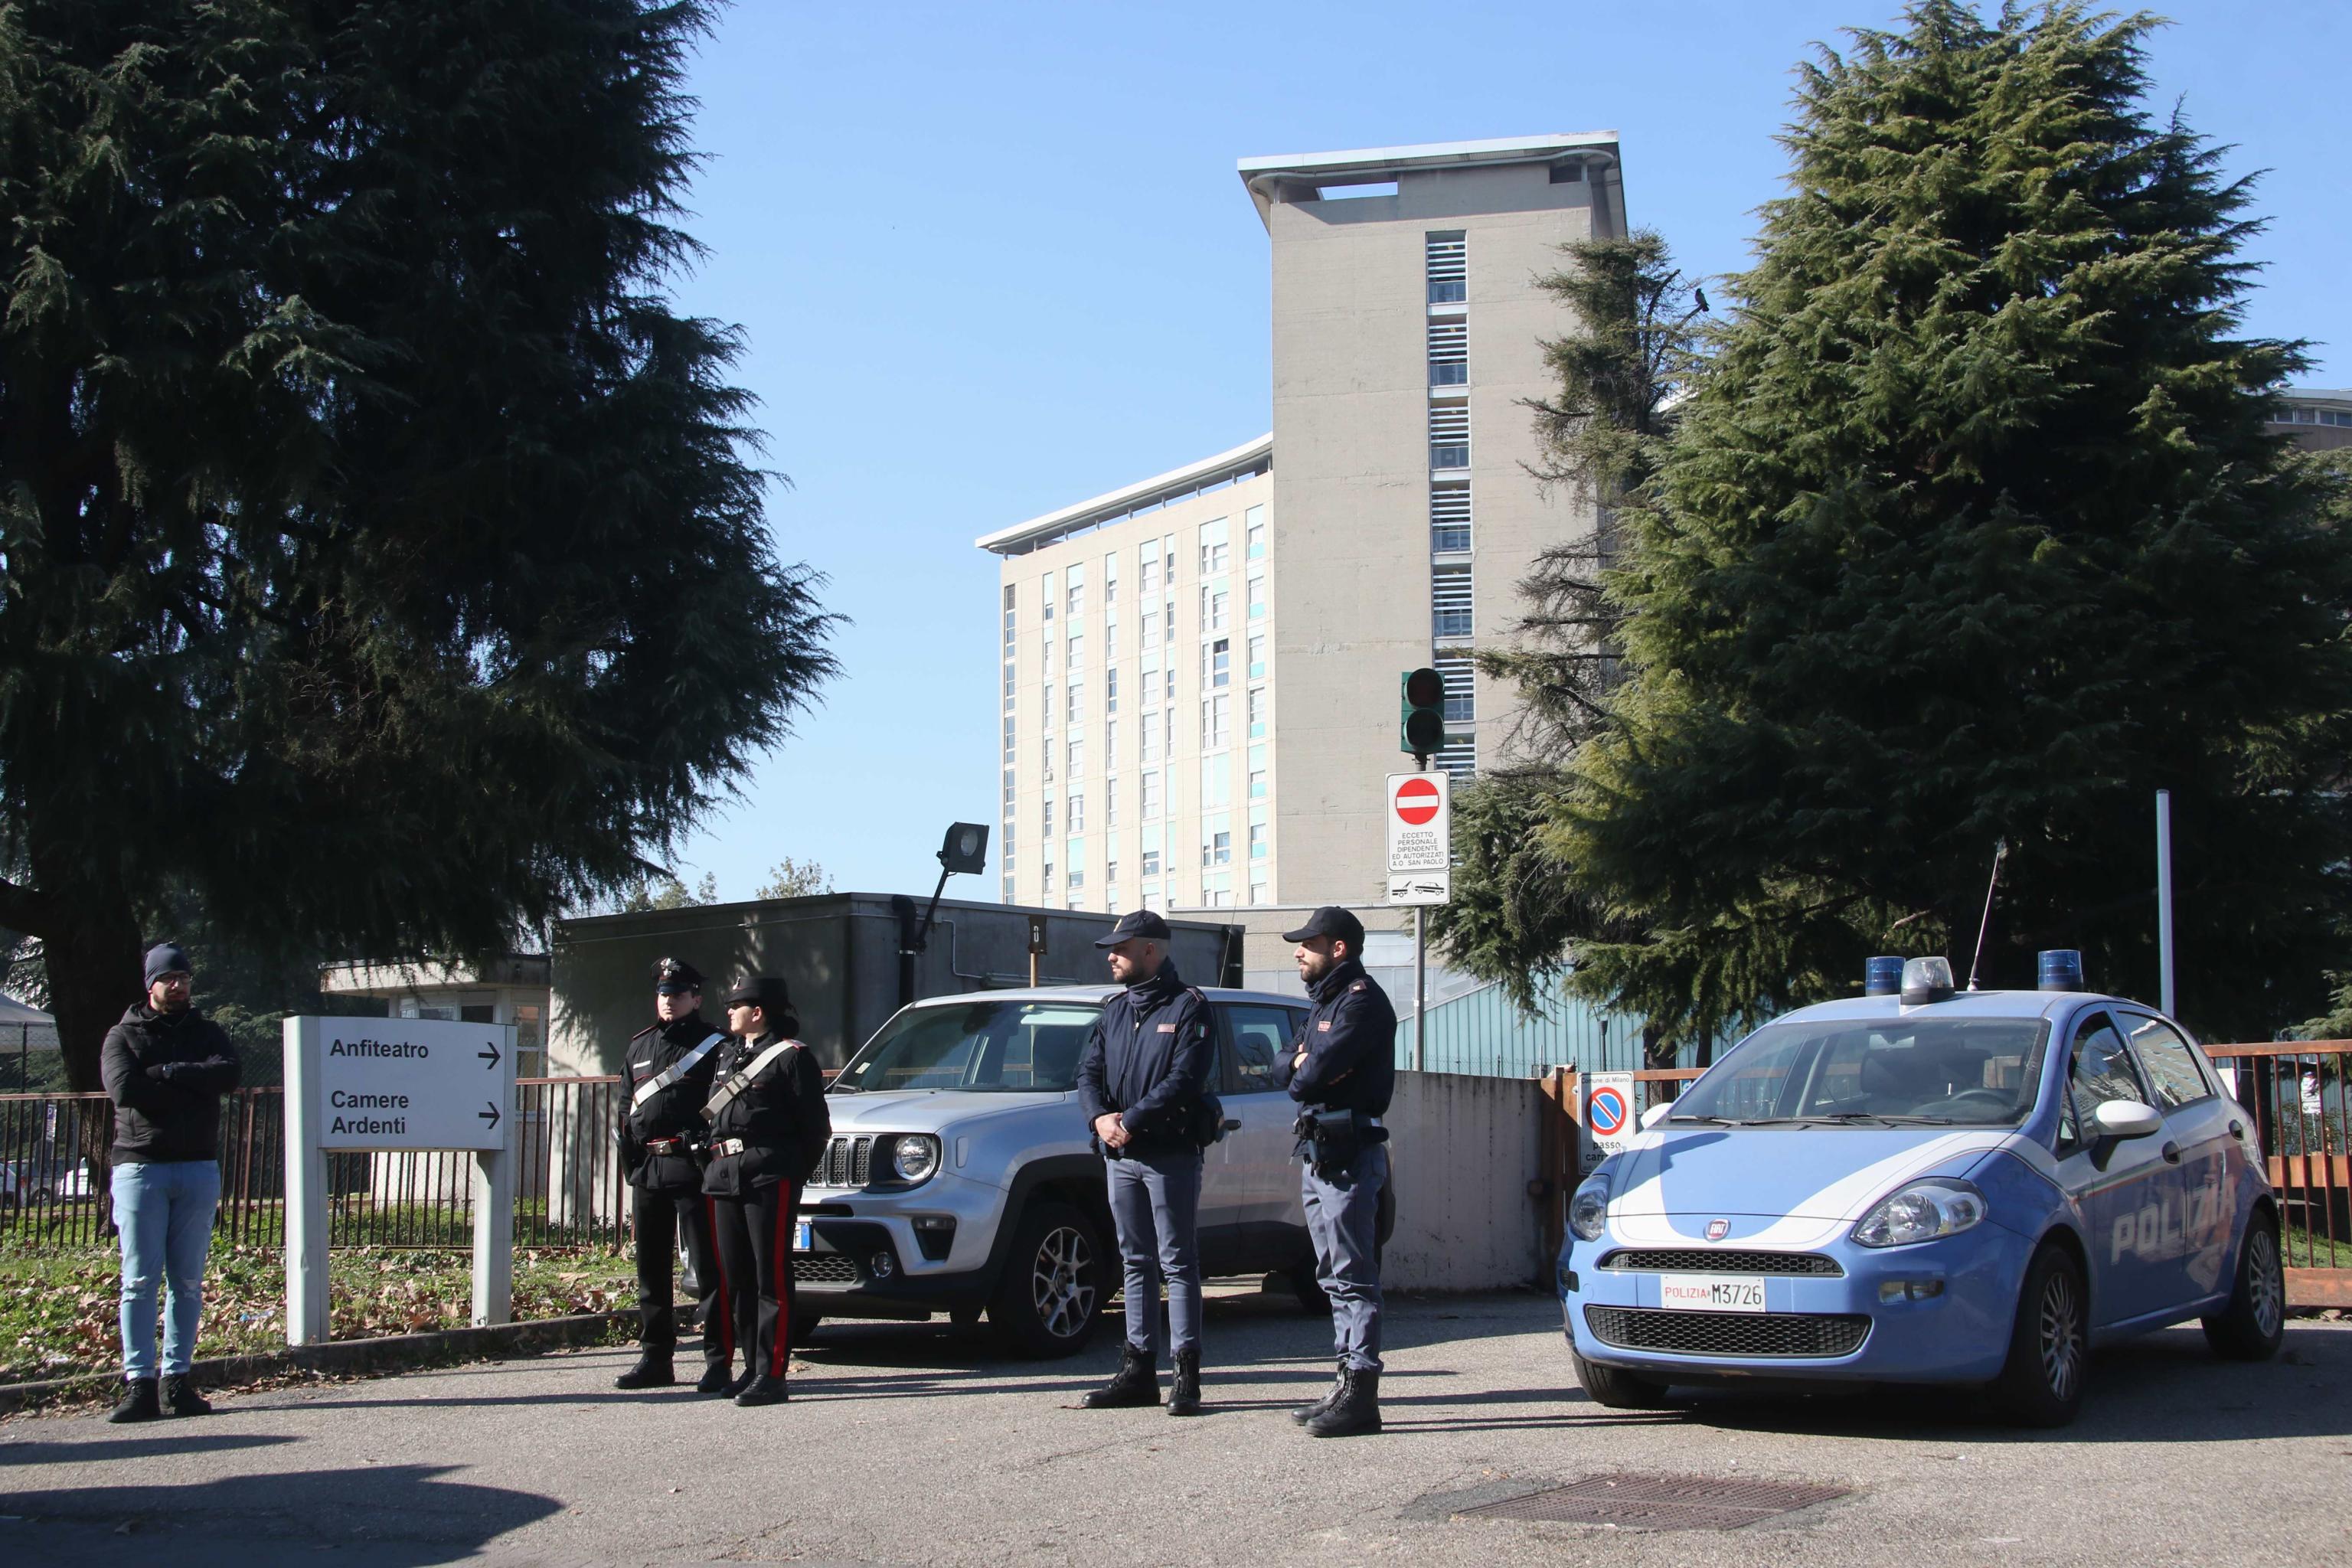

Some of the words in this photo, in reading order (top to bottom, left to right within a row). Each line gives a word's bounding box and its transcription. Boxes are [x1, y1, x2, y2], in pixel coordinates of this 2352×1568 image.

[1397, 844, 1439, 853] DIPENDENTE
[330, 1038, 429, 1059] Anfiteatro
[331, 1090, 409, 1109] Camere
[331, 1116, 406, 1135] Ardenti
[1592, 1142, 1621, 1151] passo
[1710, 1223, 1725, 1234] FIAT
[2111, 1174, 2236, 1265] POLIZIA
[1664, 1286, 1707, 1298] POLIZIA
[1711, 1284, 1762, 1305] M3726
